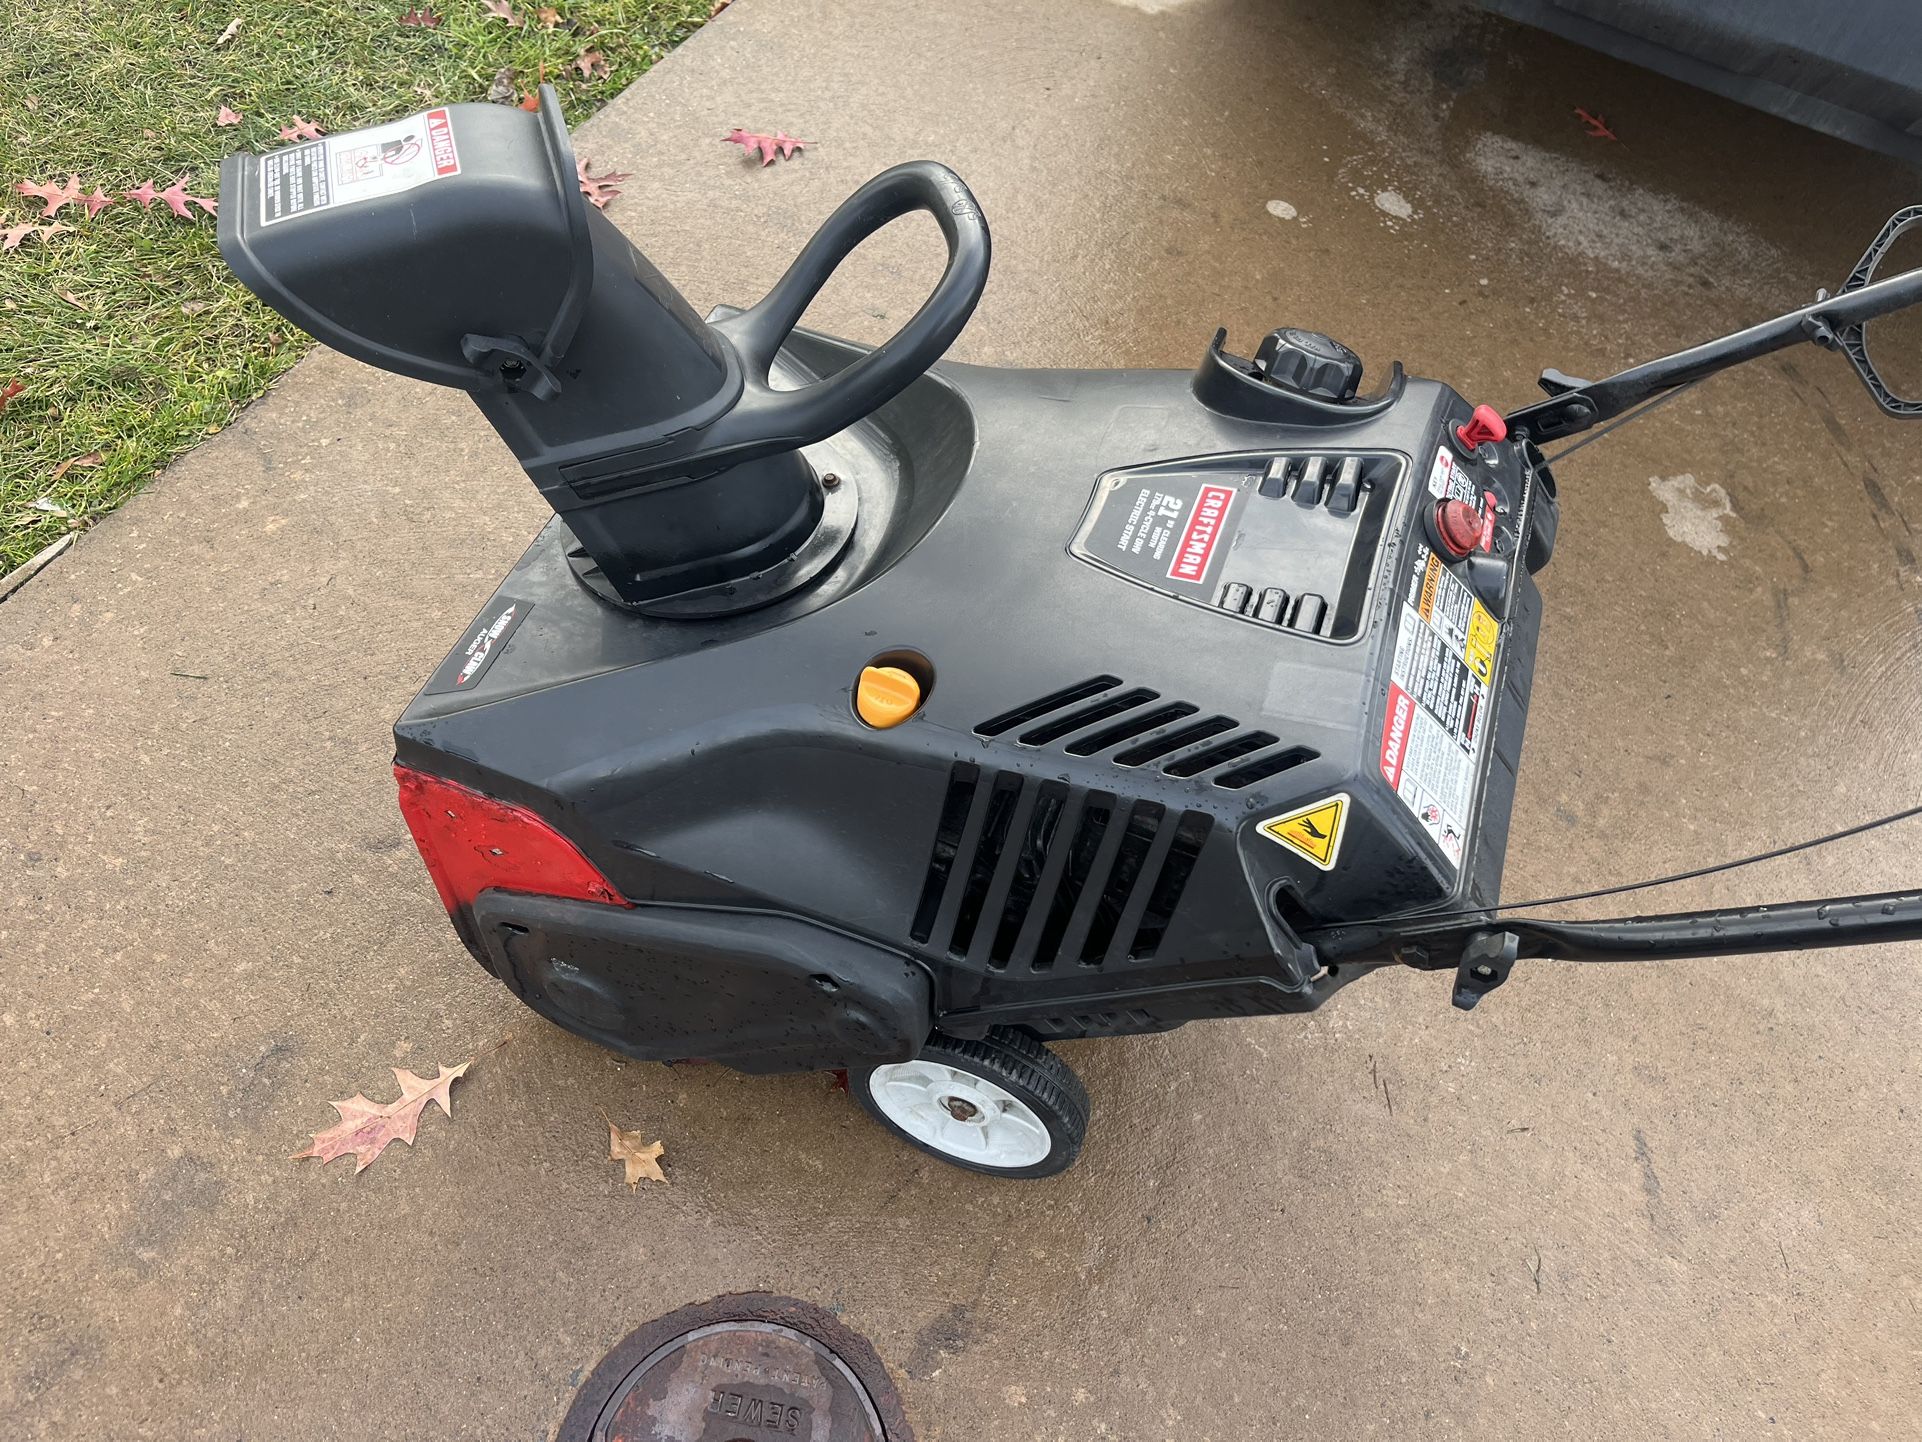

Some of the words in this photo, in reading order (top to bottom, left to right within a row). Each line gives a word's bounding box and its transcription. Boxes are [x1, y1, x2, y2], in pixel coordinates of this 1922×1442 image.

[432, 127, 455, 169] DANGER
[1127, 490, 1149, 528] ELECTRIC
[1137, 511, 1155, 538] 4-CYCLE
[1118, 526, 1134, 551] START
[1133, 539, 1145, 555] OHV
[1148, 527, 1161, 548] WIDTH
[1154, 530, 1170, 560] CLEARING
[1180, 492, 1225, 576] CRAFTSMAN
[1407, 575, 1420, 607] PRIMER
[1422, 557, 1441, 609] WARNING
[466, 628, 488, 656] AUGER
[1393, 646, 1406, 677] STARTING
[1385, 694, 1411, 766] DANGER
[771, 1367, 827, 1390] PATENT
[708, 1390, 802, 1430] SEWER
